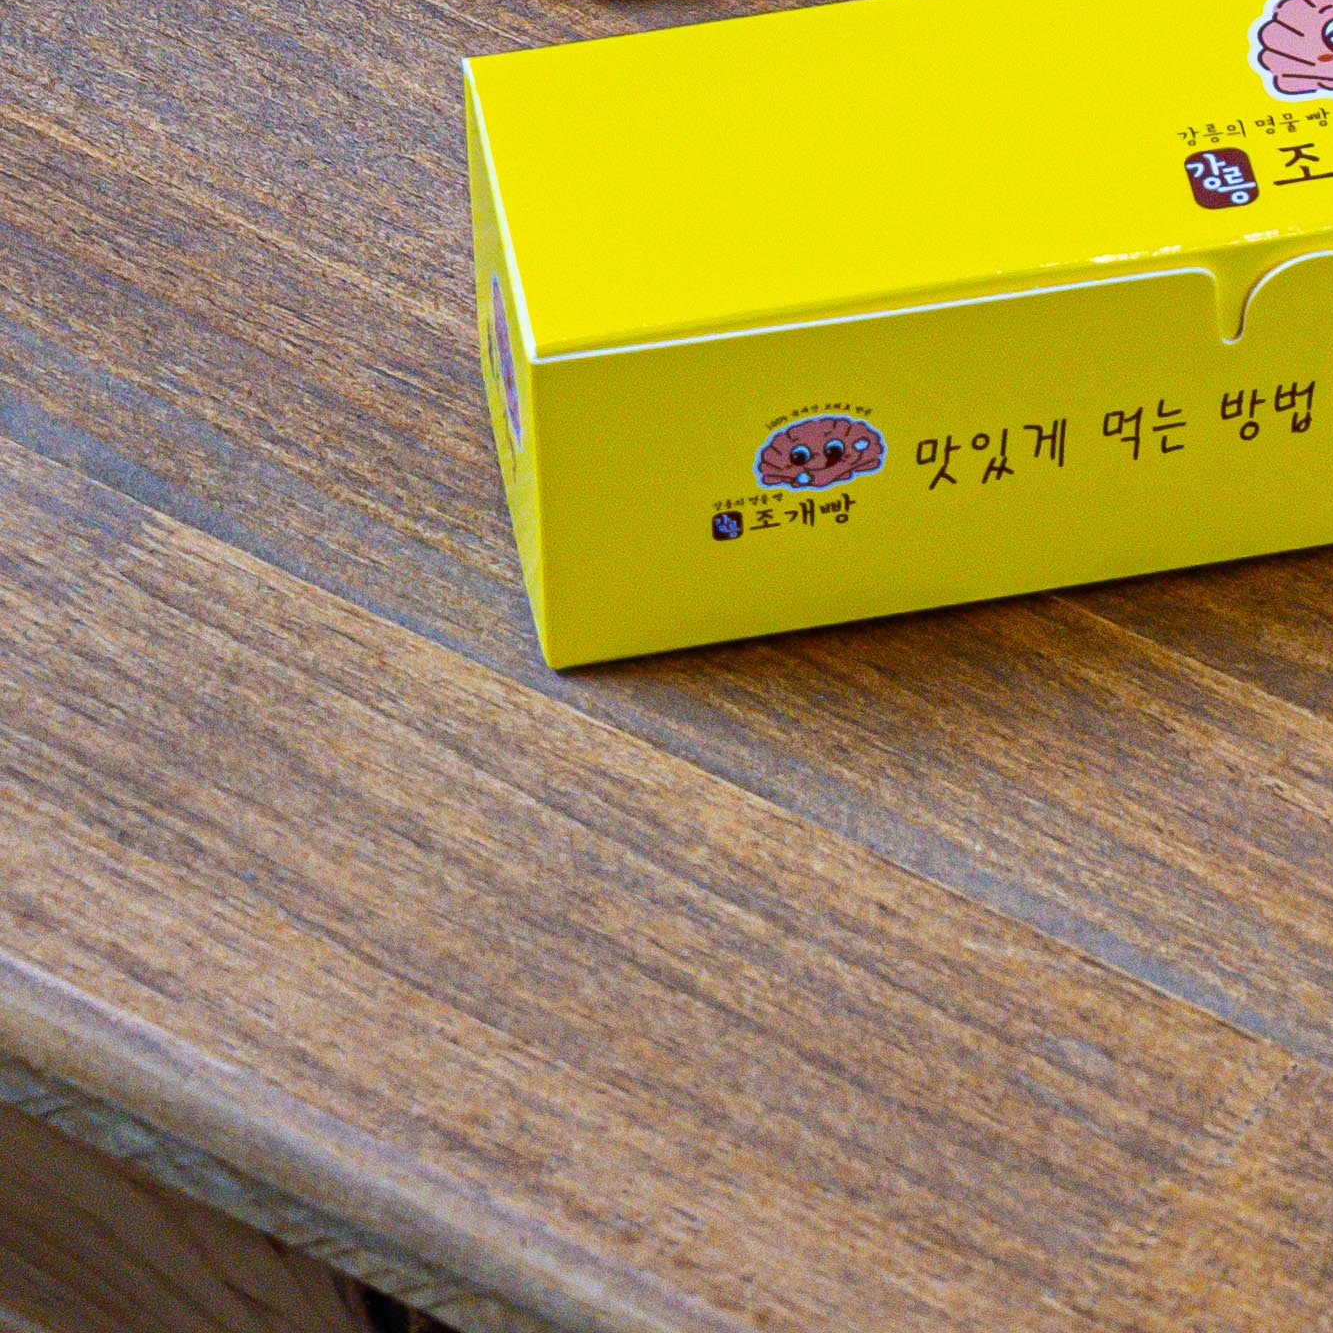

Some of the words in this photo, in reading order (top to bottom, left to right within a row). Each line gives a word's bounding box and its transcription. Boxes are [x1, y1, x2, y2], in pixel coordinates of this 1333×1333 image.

[1179, 120, 1246, 146] 강릉의
[1255, 113, 1298, 134] 명물
[1306, 108, 1329, 126] 빵
[1186, 153, 1256, 204] 강릉
[916, 418, 1067, 490] 맛있게
[1103, 399, 1186, 460] 먹는
[1221, 381, 1316, 441] 방법
[749, 492, 856, 530] 조개빵
